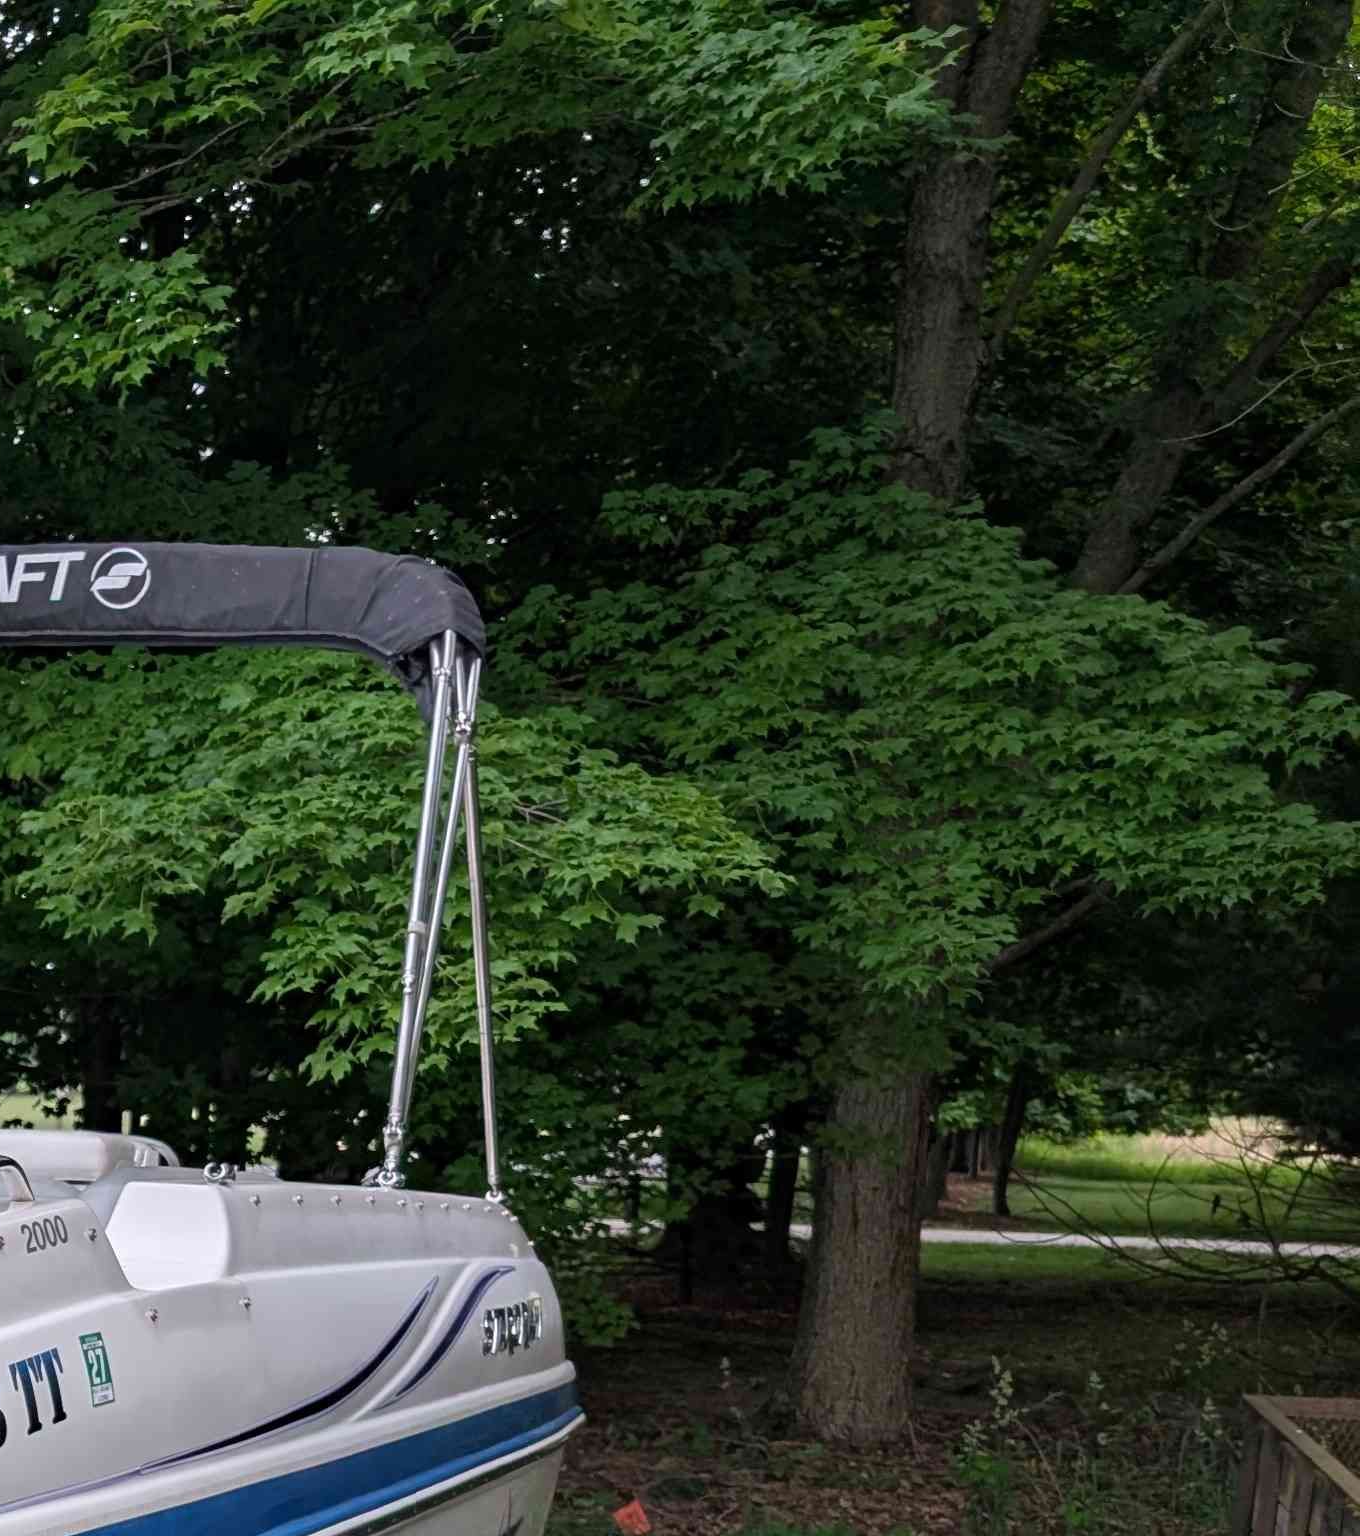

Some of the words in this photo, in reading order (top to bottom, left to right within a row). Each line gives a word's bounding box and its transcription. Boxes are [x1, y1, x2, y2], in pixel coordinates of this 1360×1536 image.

[20, 1214, 69, 1255] 2000
[87, 1347, 108, 1386] 27
[8, 1346, 69, 1436] TT
